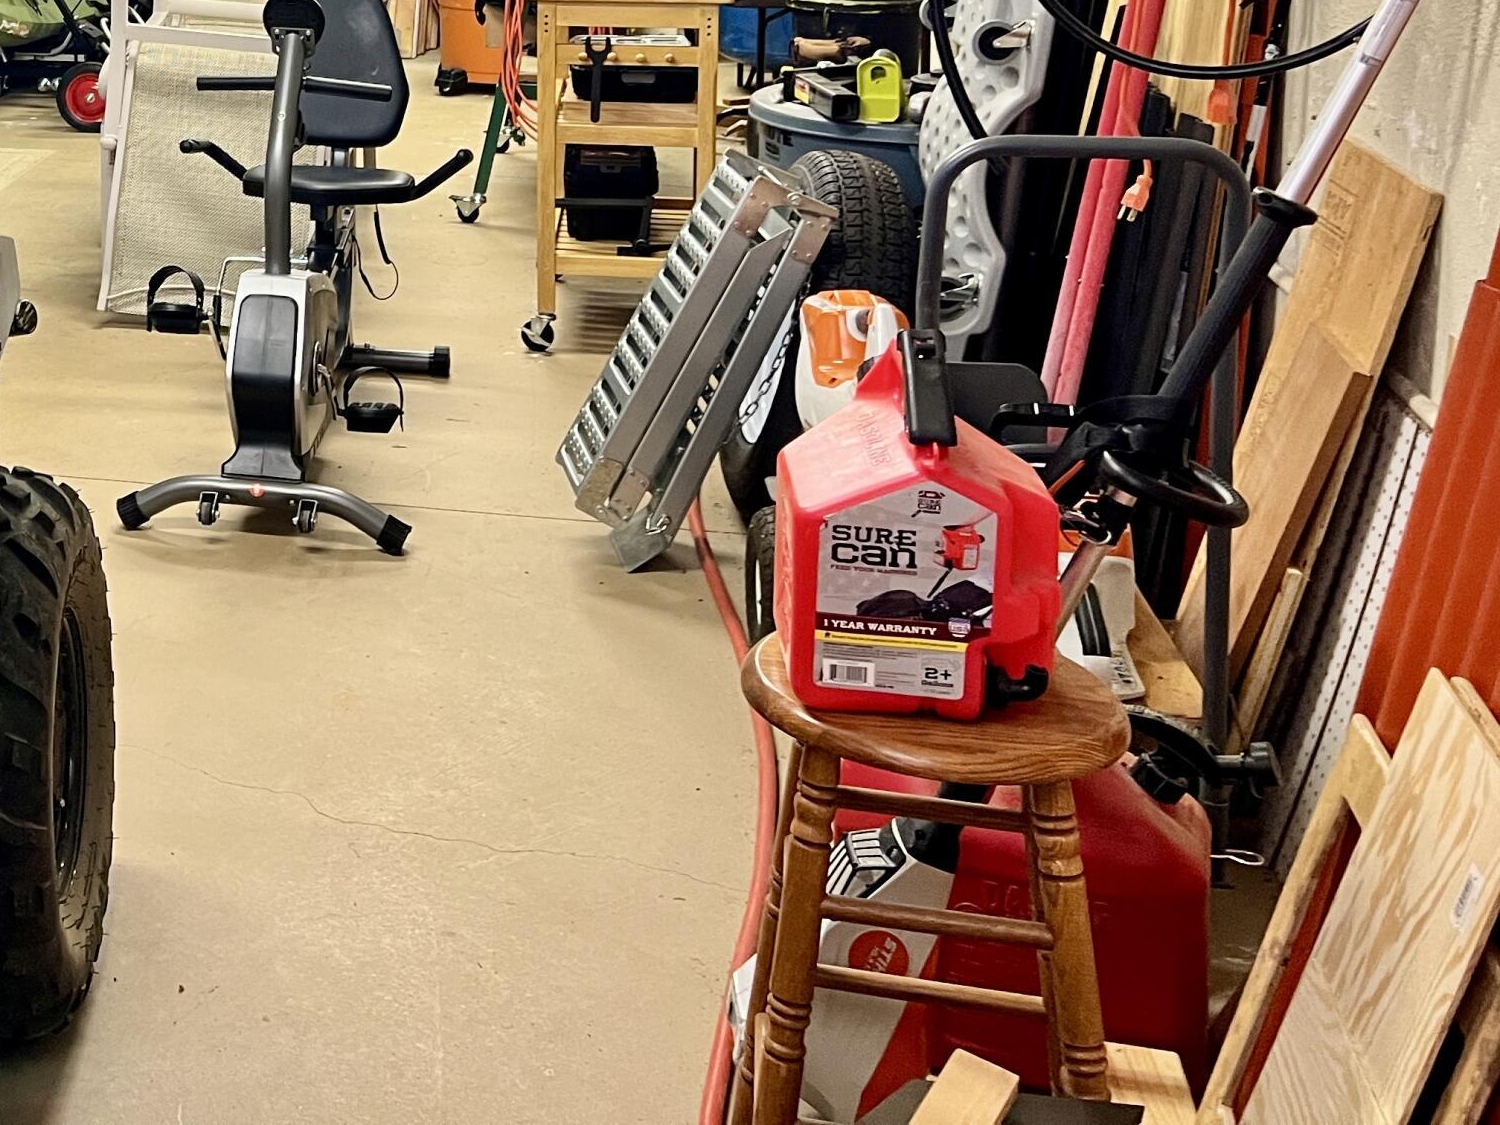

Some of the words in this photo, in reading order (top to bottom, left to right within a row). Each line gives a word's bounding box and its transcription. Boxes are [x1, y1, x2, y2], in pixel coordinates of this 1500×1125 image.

[831, 525, 917, 547] SURE
[823, 618, 828, 627] 1
[831, 619, 865, 631] YEAR
[867, 622, 937, 636] WARRANTY
[924, 667, 953, 681] 2+
